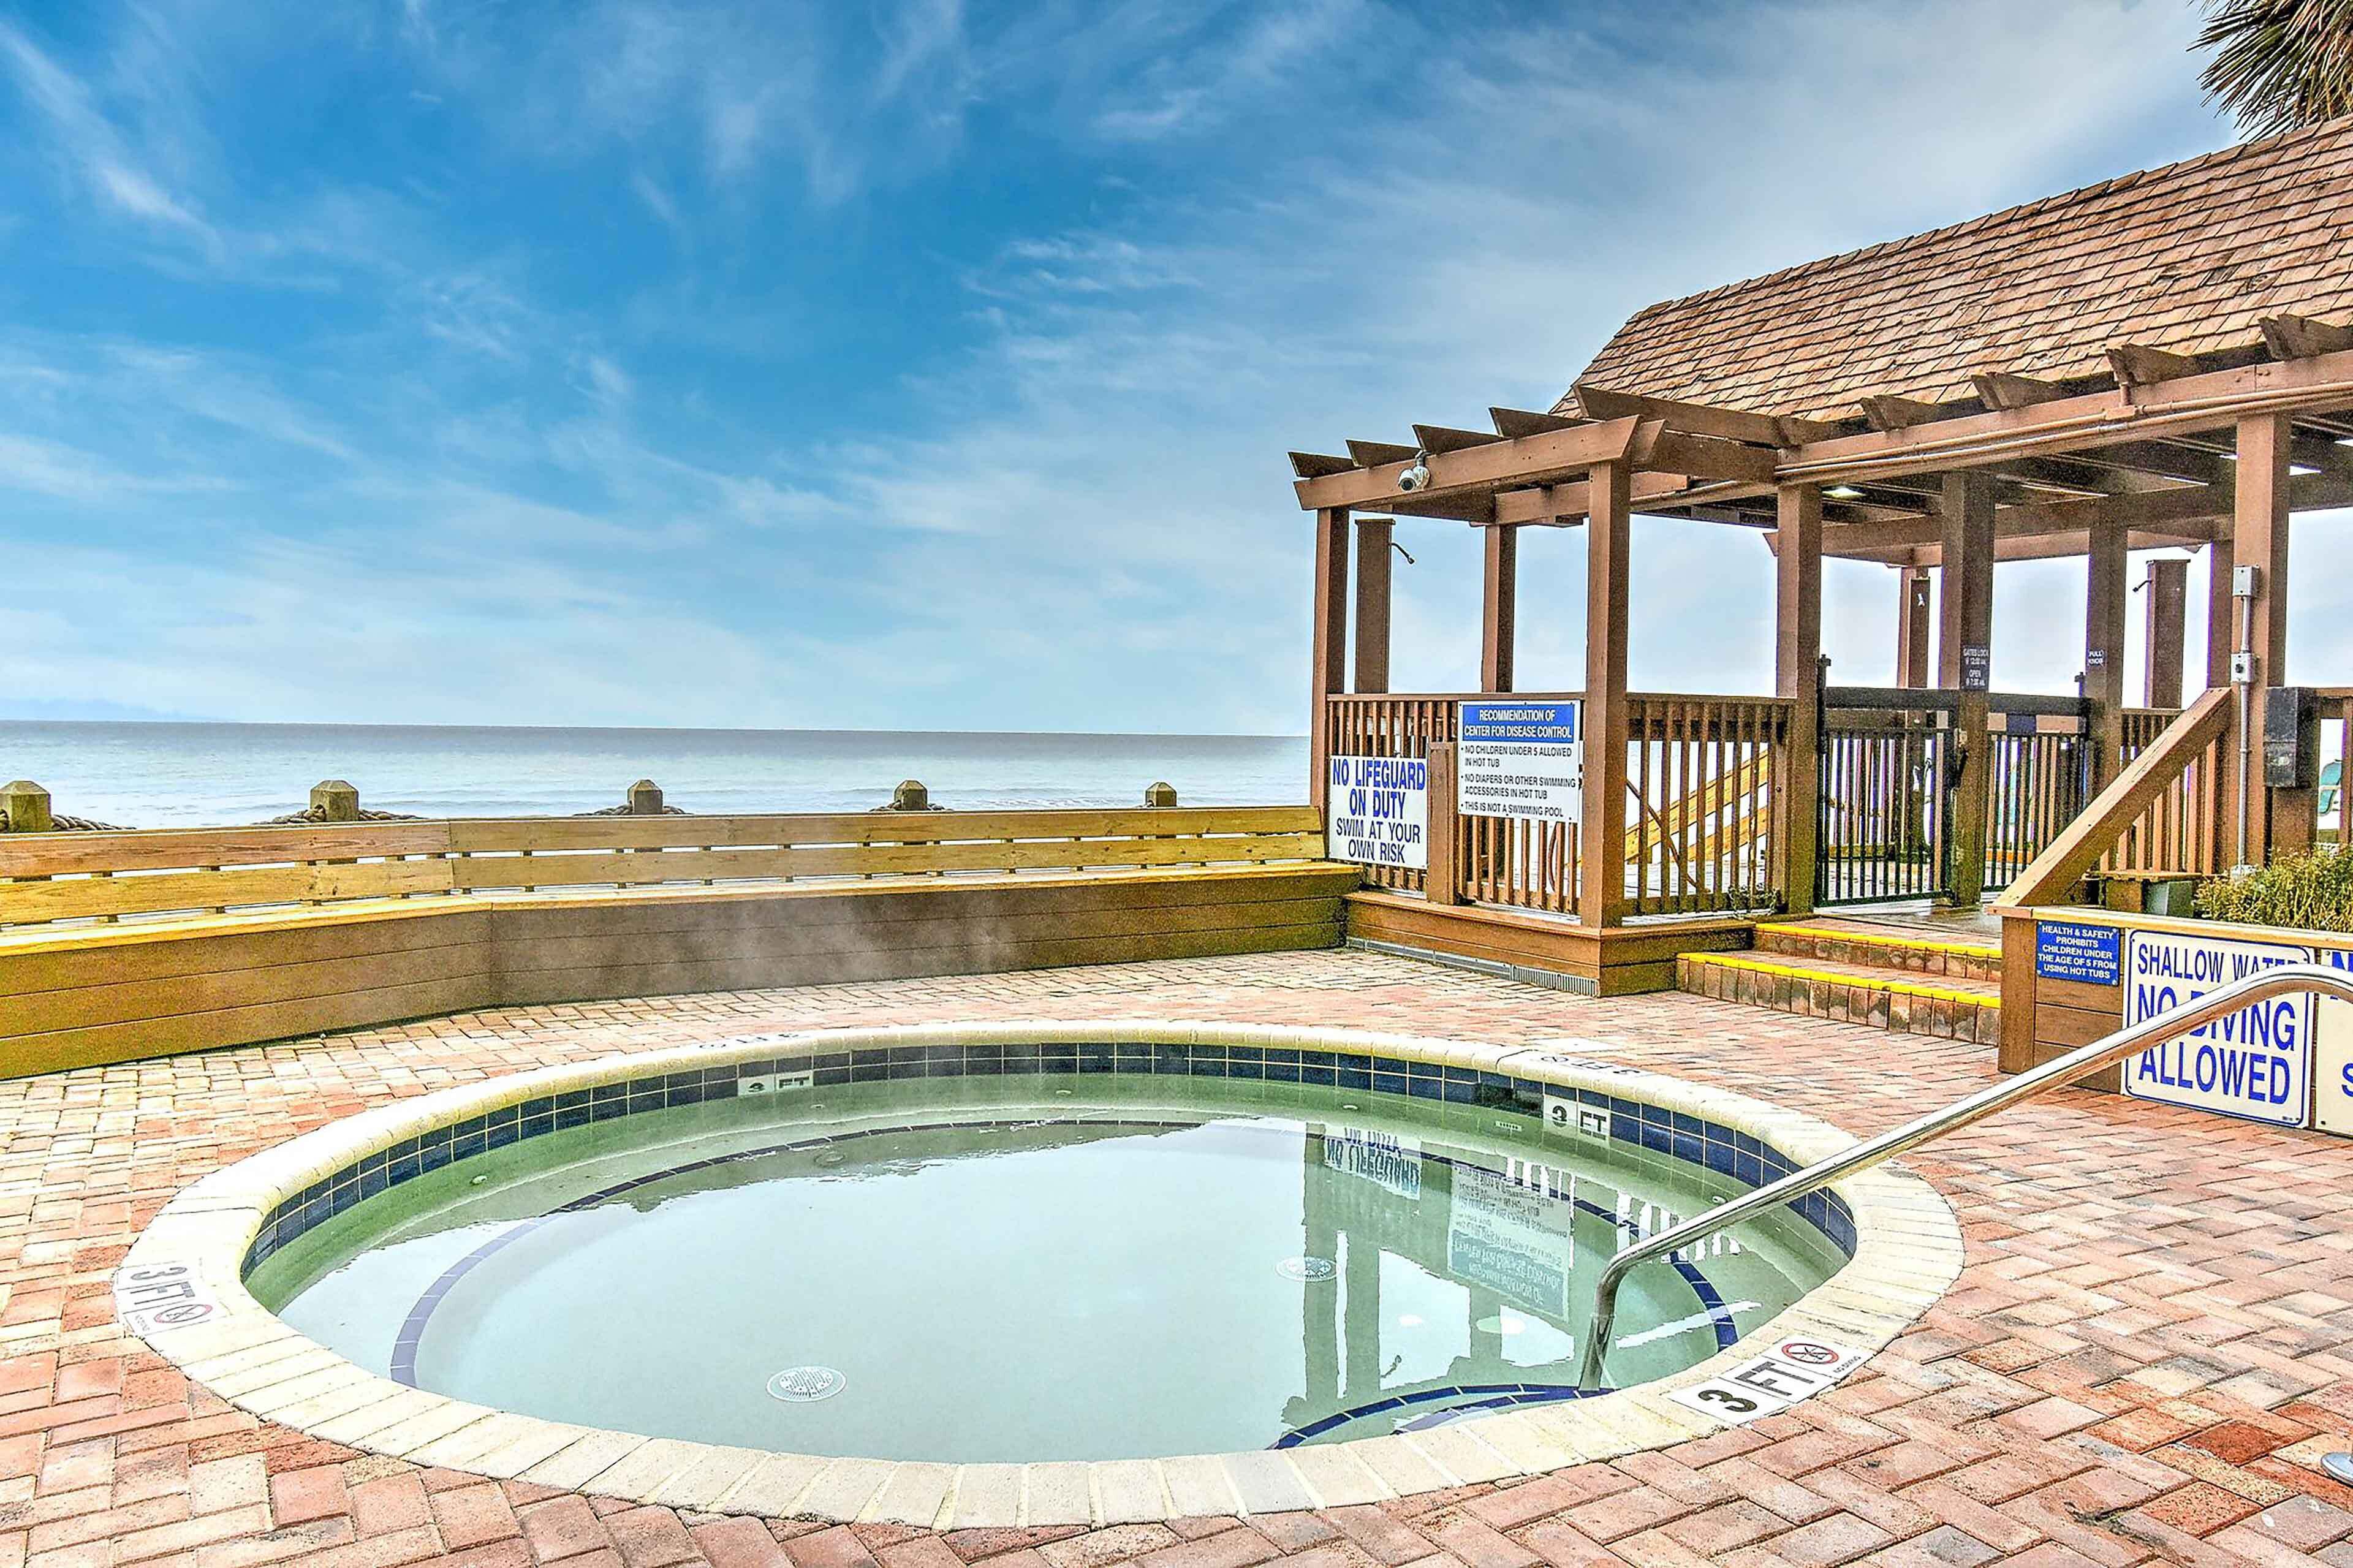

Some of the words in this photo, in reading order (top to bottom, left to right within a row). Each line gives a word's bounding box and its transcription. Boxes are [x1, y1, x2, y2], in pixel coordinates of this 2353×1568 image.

[1479, 710, 1545, 721] RECOMMENDATION
[1545, 710, 1556, 722] OF
[1464, 725, 1490, 736] CENTER
[1491, 725, 1506, 737] FOR
[1507, 726, 1536, 737] DISEASE
[1537, 727, 1572, 738] CONTROL
[1465, 746, 1474, 754] NO
[1476, 745, 1507, 755] CHILDREN
[1509, 747, 1532, 756] UNDER
[1534, 747, 1537, 756] 5
[1539, 747, 1572, 757] ALLOWED
[1472, 758, 1485, 767] HOT
[1487, 759, 1500, 767] TUB
[1333, 759, 1349, 786] NO
[1355, 760, 1425, 790] LIFEGUARD
[1464, 774, 1474, 782] NO
[1476, 774, 1502, 784] DIAPERS
[1504, 775, 1514, 784] OR
[1515, 776, 1538, 786] OTHER
[1539, 776, 1575, 788] SWIMMING
[1464, 786, 1509, 797] ACCESSORIES
[1510, 789, 1517, 797] IN
[1518, 789, 1533, 798] HOT
[1534, 790, 1547, 799] TUB
[1350, 789, 1366, 816] ON
[1373, 790, 1406, 819] DUTY
[1464, 801, 1478, 811] THIS
[1487, 803, 1501, 812] NOT
[1502, 804, 1507, 812] A
[1509, 804, 1543, 816] SWIMMING
[1545, 807, 1564, 817] POOL
[1336, 817, 1363, 838] SWIM
[1369, 820, 1383, 839] AT
[1389, 822, 1420, 844] YOUR
[1349, 839, 1374, 860] OWN
[1380, 842, 1405, 863] RISK
[2042, 925, 2073, 936] HEALTH
[2082, 929, 2113, 939] SAFETY
[2056, 936, 2099, 948] PROHIBITS
[2042, 944, 2082, 956] CHILDREN
[2084, 949, 2112, 959] UNDER
[2038, 953, 2054, 962] THE
[2055, 955, 2072, 964] AGE
[2074, 957, 2085, 966] OF
[2093, 960, 2117, 969] FROM
[2138, 943, 2224, 983] SHALLOW
[2044, 964, 2068, 974] USING
[2070, 966, 2087, 975] HOT
[2088, 969, 2110, 979] TUBS
[2138, 983, 2177, 1023] NO
[2138, 1042, 2290, 1105] ALLOWED
[1552, 1105, 1567, 1126] 3
[1580, 1110, 1607, 1132] FT
[130, 1267, 188, 1281] 3
[130, 1281, 195, 1305] FT
[1698, 1389, 1758, 1412] 3
[1735, 1361, 1815, 1397] FT
